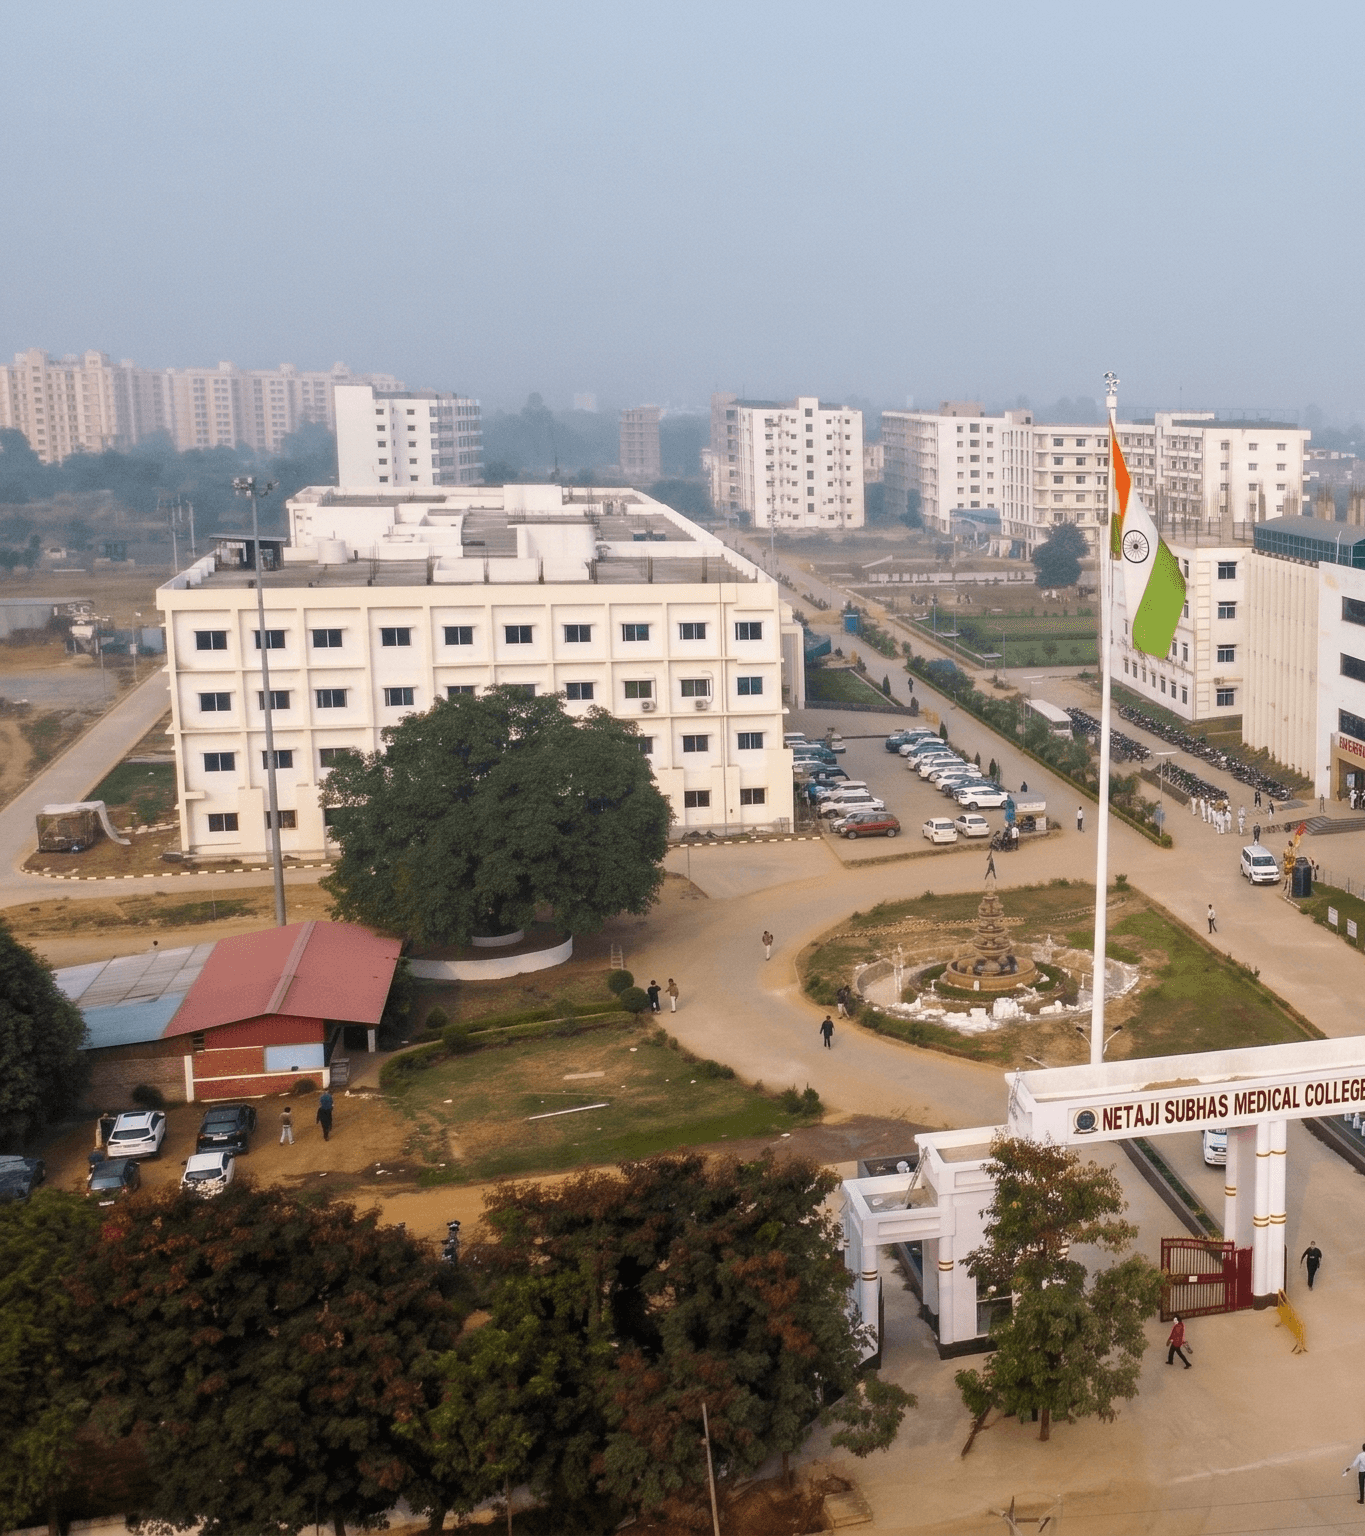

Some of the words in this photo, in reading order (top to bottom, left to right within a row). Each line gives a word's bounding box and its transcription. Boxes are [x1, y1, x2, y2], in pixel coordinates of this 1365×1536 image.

[1102, 1102, 1160, 1131] NETAJI
[1164, 1094, 1229, 1124] SUBHAS
[1234, 1086, 1300, 1116] MEDICAL
